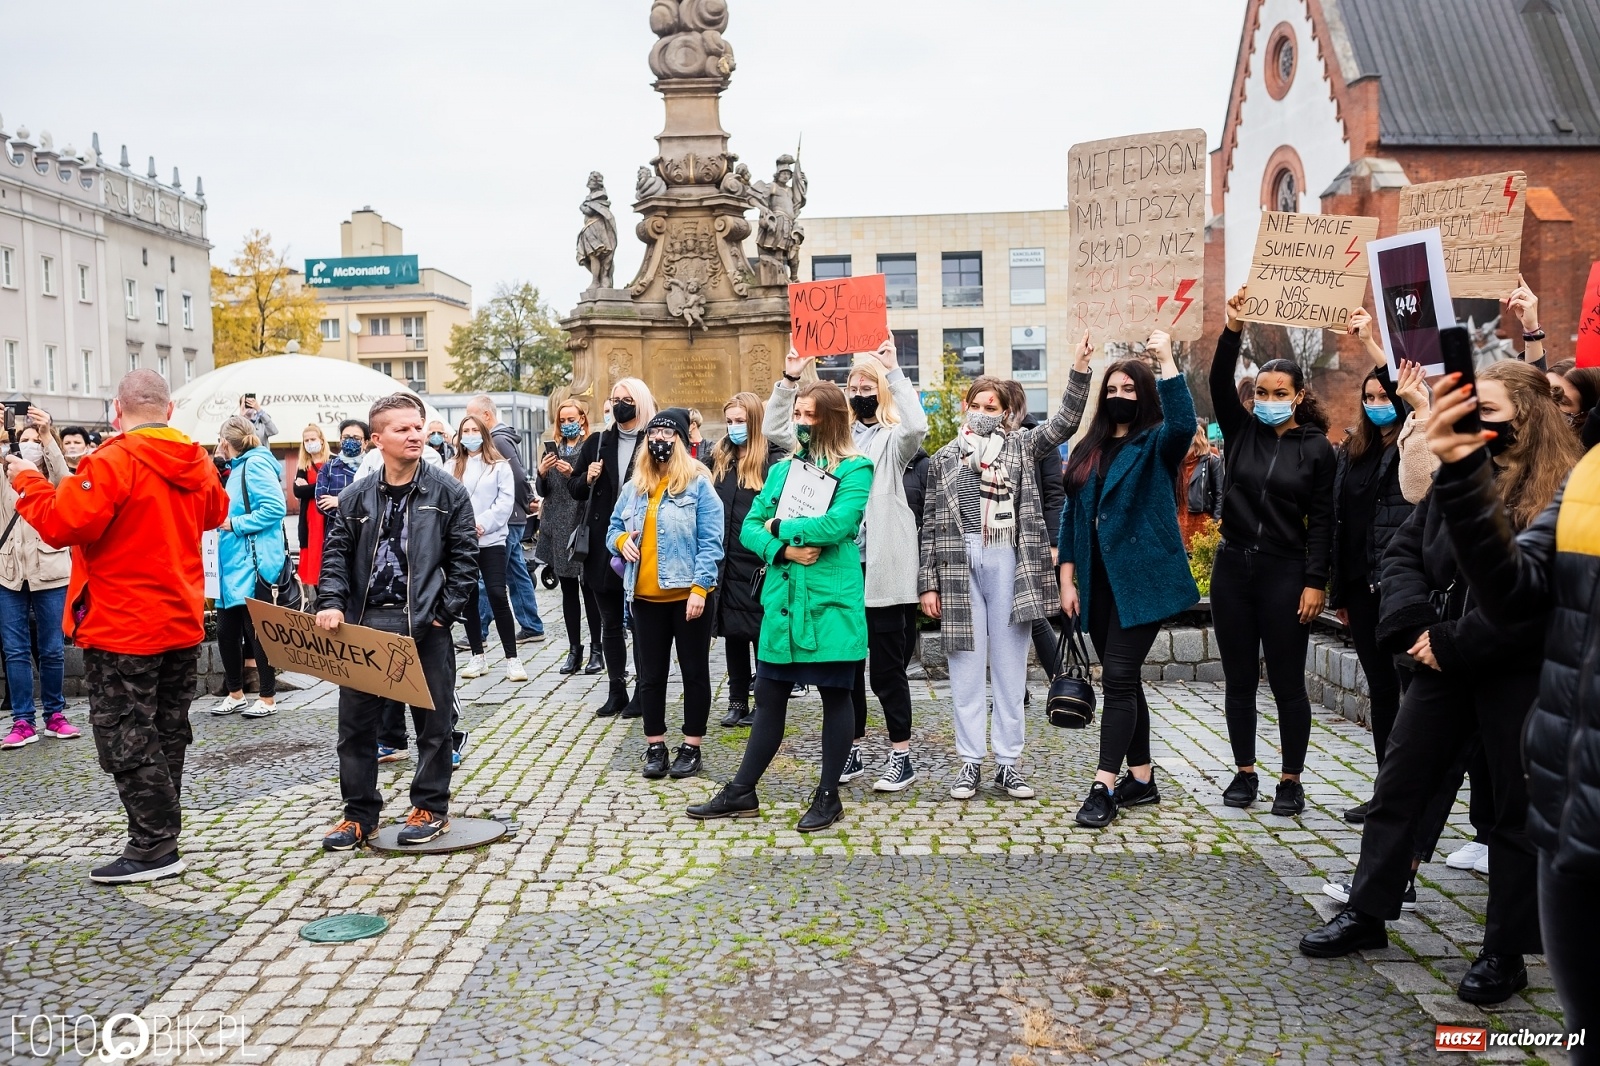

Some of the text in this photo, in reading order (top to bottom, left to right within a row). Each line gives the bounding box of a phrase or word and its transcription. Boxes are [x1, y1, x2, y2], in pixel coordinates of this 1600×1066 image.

[1076, 142, 1199, 196] MEFEDRON
[1076, 193, 1196, 234] MA LEPSZY
[1409, 184, 1494, 216] WALCZCIE Z
[1266, 214, 1353, 235] NIE MACIE
[1478, 211, 1506, 236] NIE
[1078, 227, 1196, 268] SKŁAD NIŻ
[1261, 240, 1335, 260] SUMIENIA
[1443, 245, 1511, 274] BIETAMI
[333, 265, 391, 277] McDonald's
[1085, 263, 1176, 295] POLSKI
[1257, 262, 1347, 289] ZMUSZAJĄC
[793, 283, 884, 320] MOJE CIAŁO
[1280, 285, 1311, 302] NAS
[1243, 296, 1349, 324] DO RODZENIA
[848, 328, 884, 350] WYBÓR
[260, 392, 381, 407] BROWAR RACIBÓR
[316, 411, 348, 424] 1567
[284, 611, 317, 633] STOP
[283, 646, 351, 679] SZCZEPIEŃ
